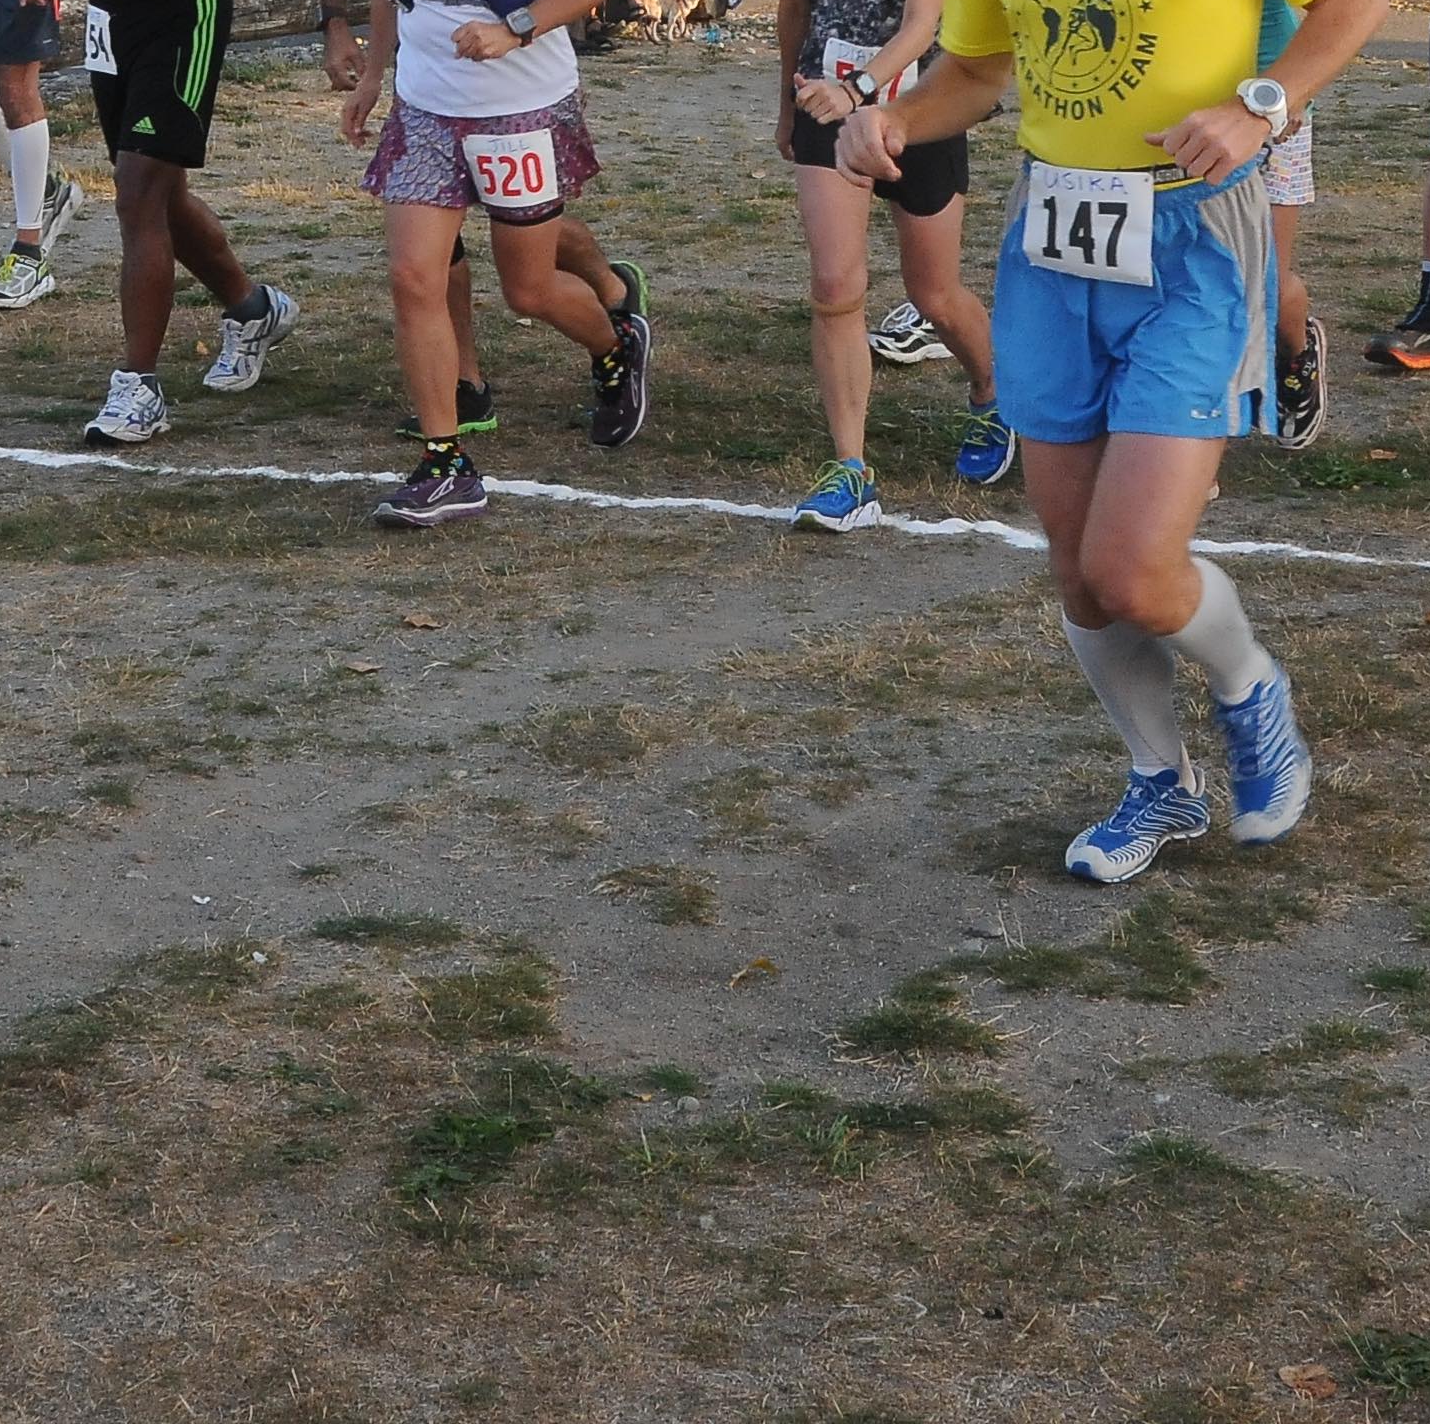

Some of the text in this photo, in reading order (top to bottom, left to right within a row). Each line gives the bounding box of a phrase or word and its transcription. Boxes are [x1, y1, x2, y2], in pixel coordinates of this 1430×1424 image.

[1108, 33, 1159, 102] TEAM
[488, 138, 530, 153] JILL
[476, 152, 543, 196] 520
[1042, 196, 1128, 267] 147
